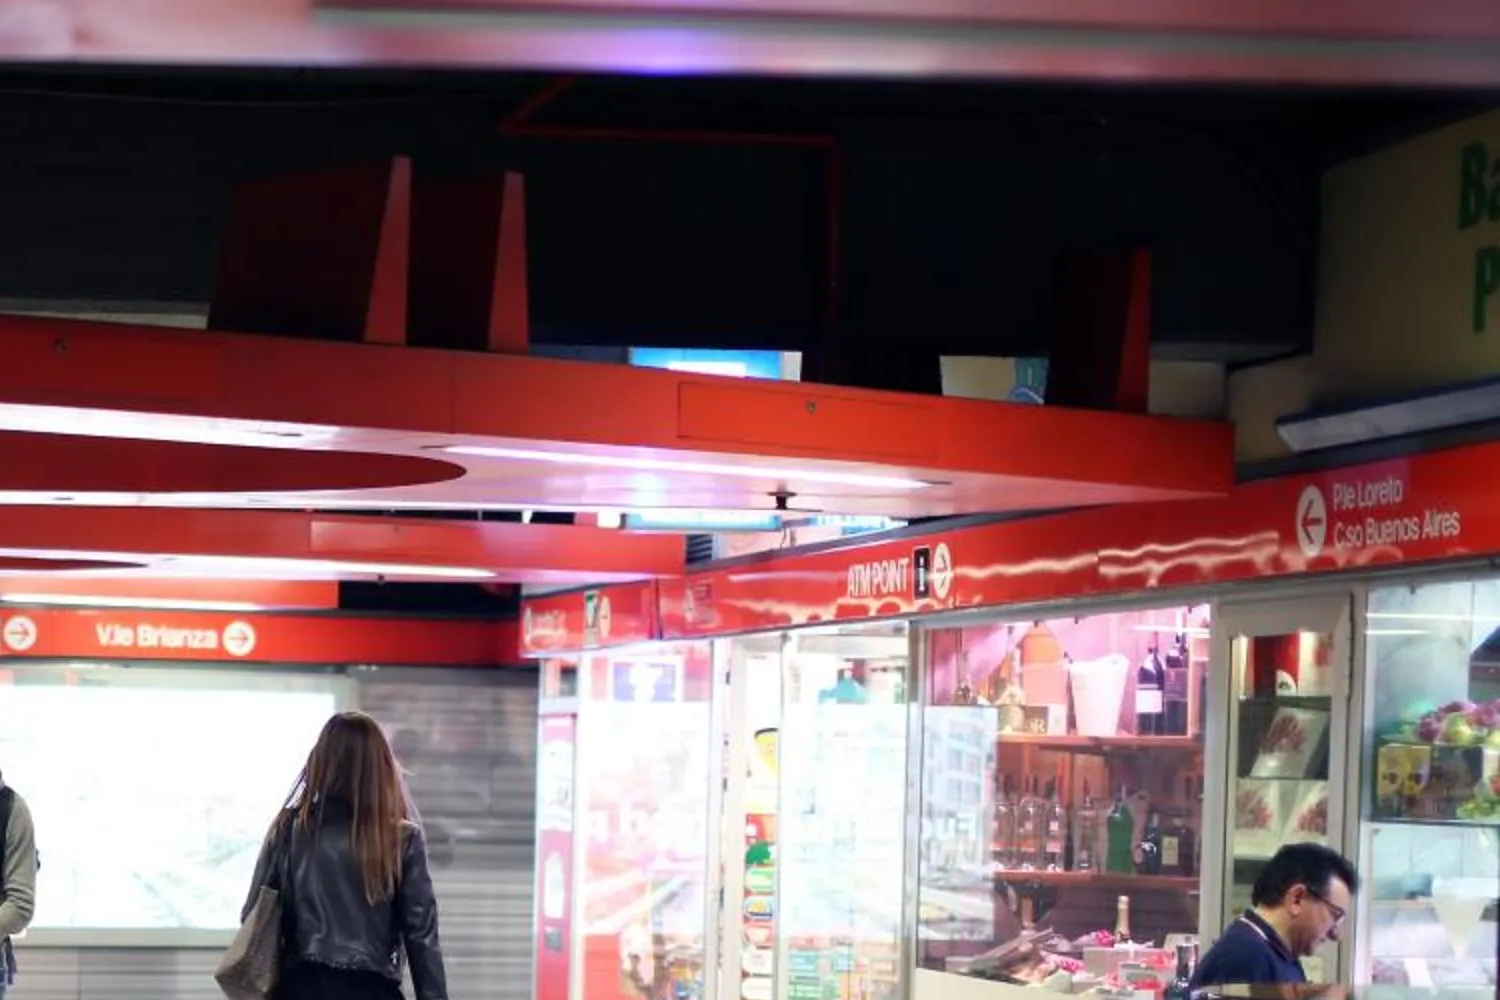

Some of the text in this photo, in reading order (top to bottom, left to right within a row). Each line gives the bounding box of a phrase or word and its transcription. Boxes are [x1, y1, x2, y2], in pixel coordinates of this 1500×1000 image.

[1358, 477, 1403, 507] Loreto
[1365, 514, 1420, 545] Buenos
[1422, 509, 1461, 539] Aires
[872, 558, 909, 594] POINT
[136, 624, 218, 649] Brianza
